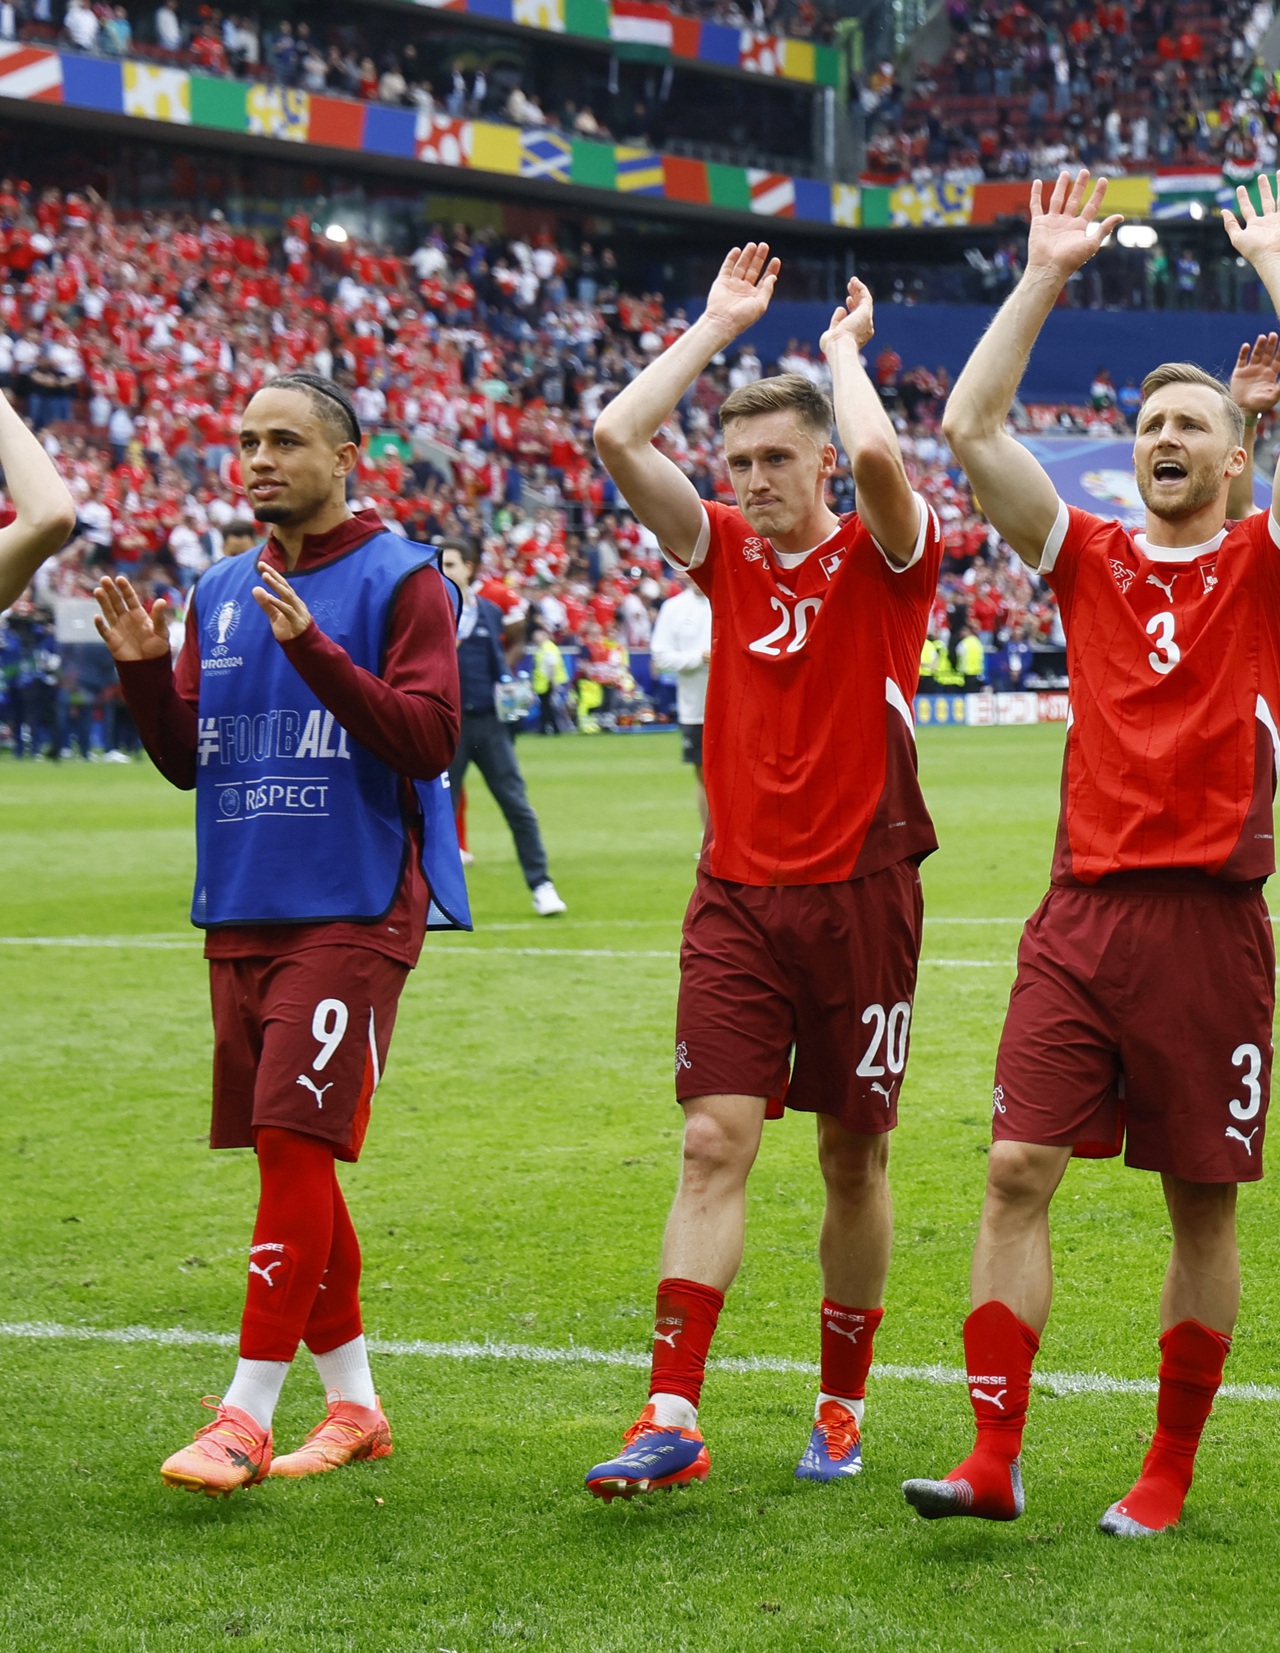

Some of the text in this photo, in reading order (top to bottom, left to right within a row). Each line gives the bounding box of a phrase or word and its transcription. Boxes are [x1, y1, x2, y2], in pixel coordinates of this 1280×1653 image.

[749, 596, 823, 656] 20
[1146, 611, 1180, 675] 3
[201, 656, 243, 669] URO2024
[312, 998, 349, 1071] 9
[856, 1001, 911, 1077] 20
[1229, 1043, 1262, 1120] 3
[824, 1307, 865, 1323] SUISSE
[968, 1375, 1007, 1385] SUISSE
